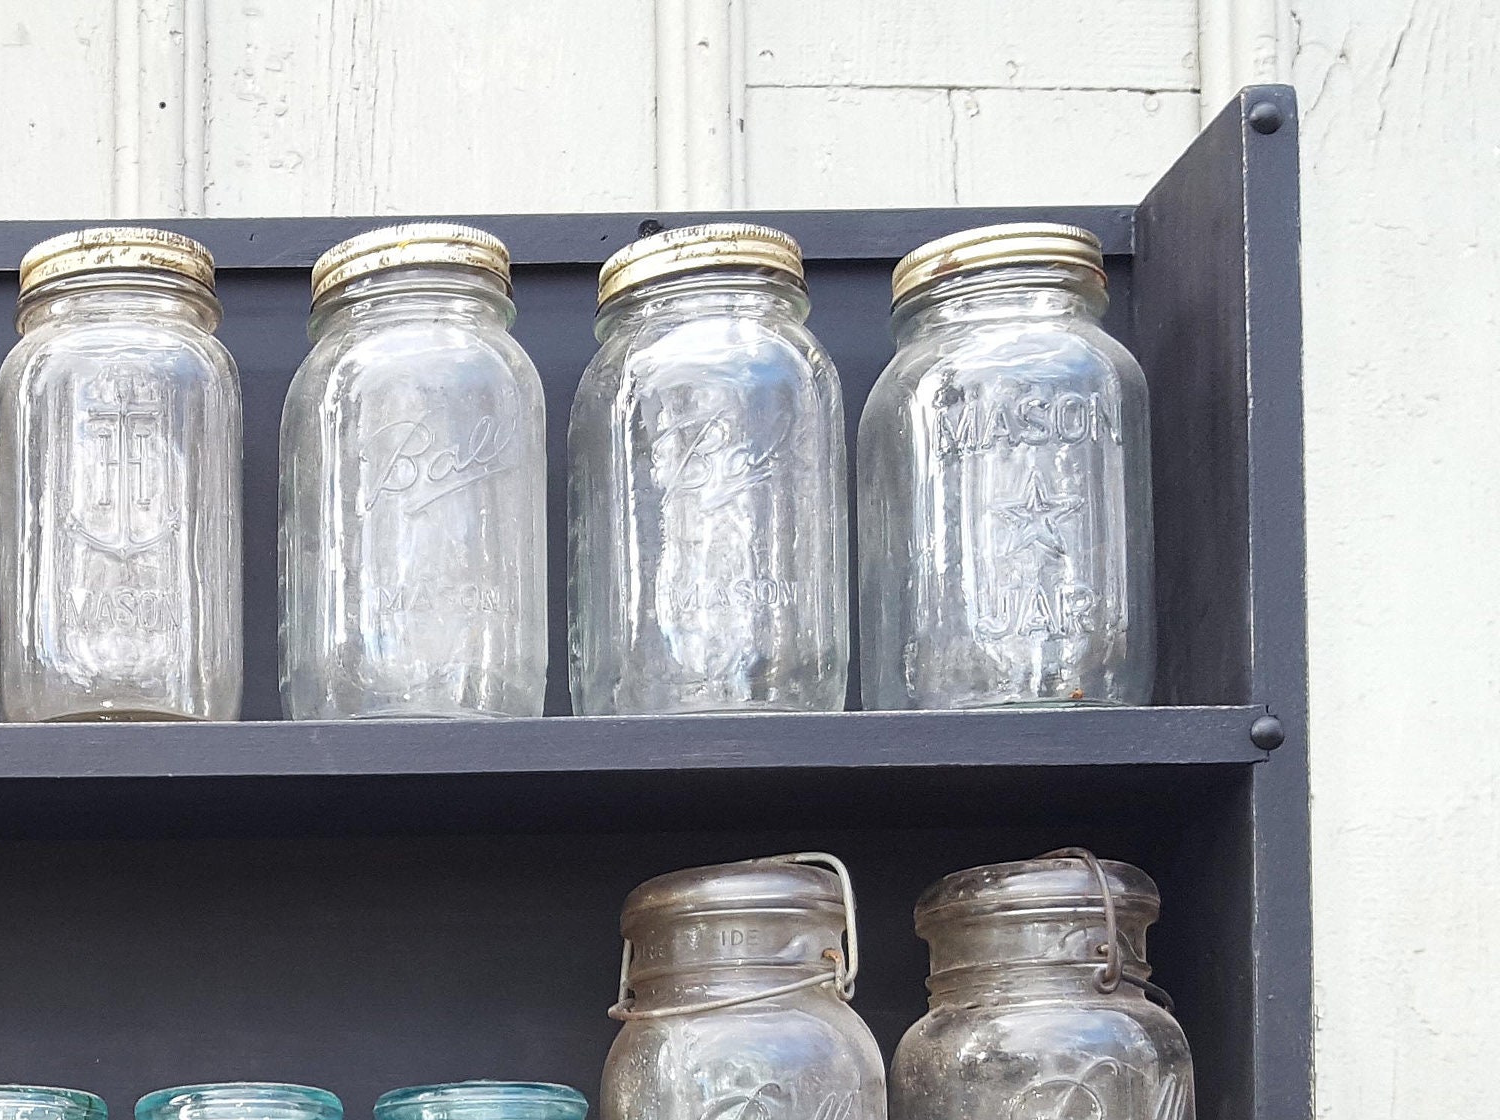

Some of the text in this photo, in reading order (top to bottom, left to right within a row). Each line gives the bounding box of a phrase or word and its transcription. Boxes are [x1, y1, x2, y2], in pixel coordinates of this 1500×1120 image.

[932, 390, 1122, 460] MASON
[358, 406, 518, 517] Ball
[63, 586, 183, 631] MASON
[974, 582, 1097, 641] JAR
